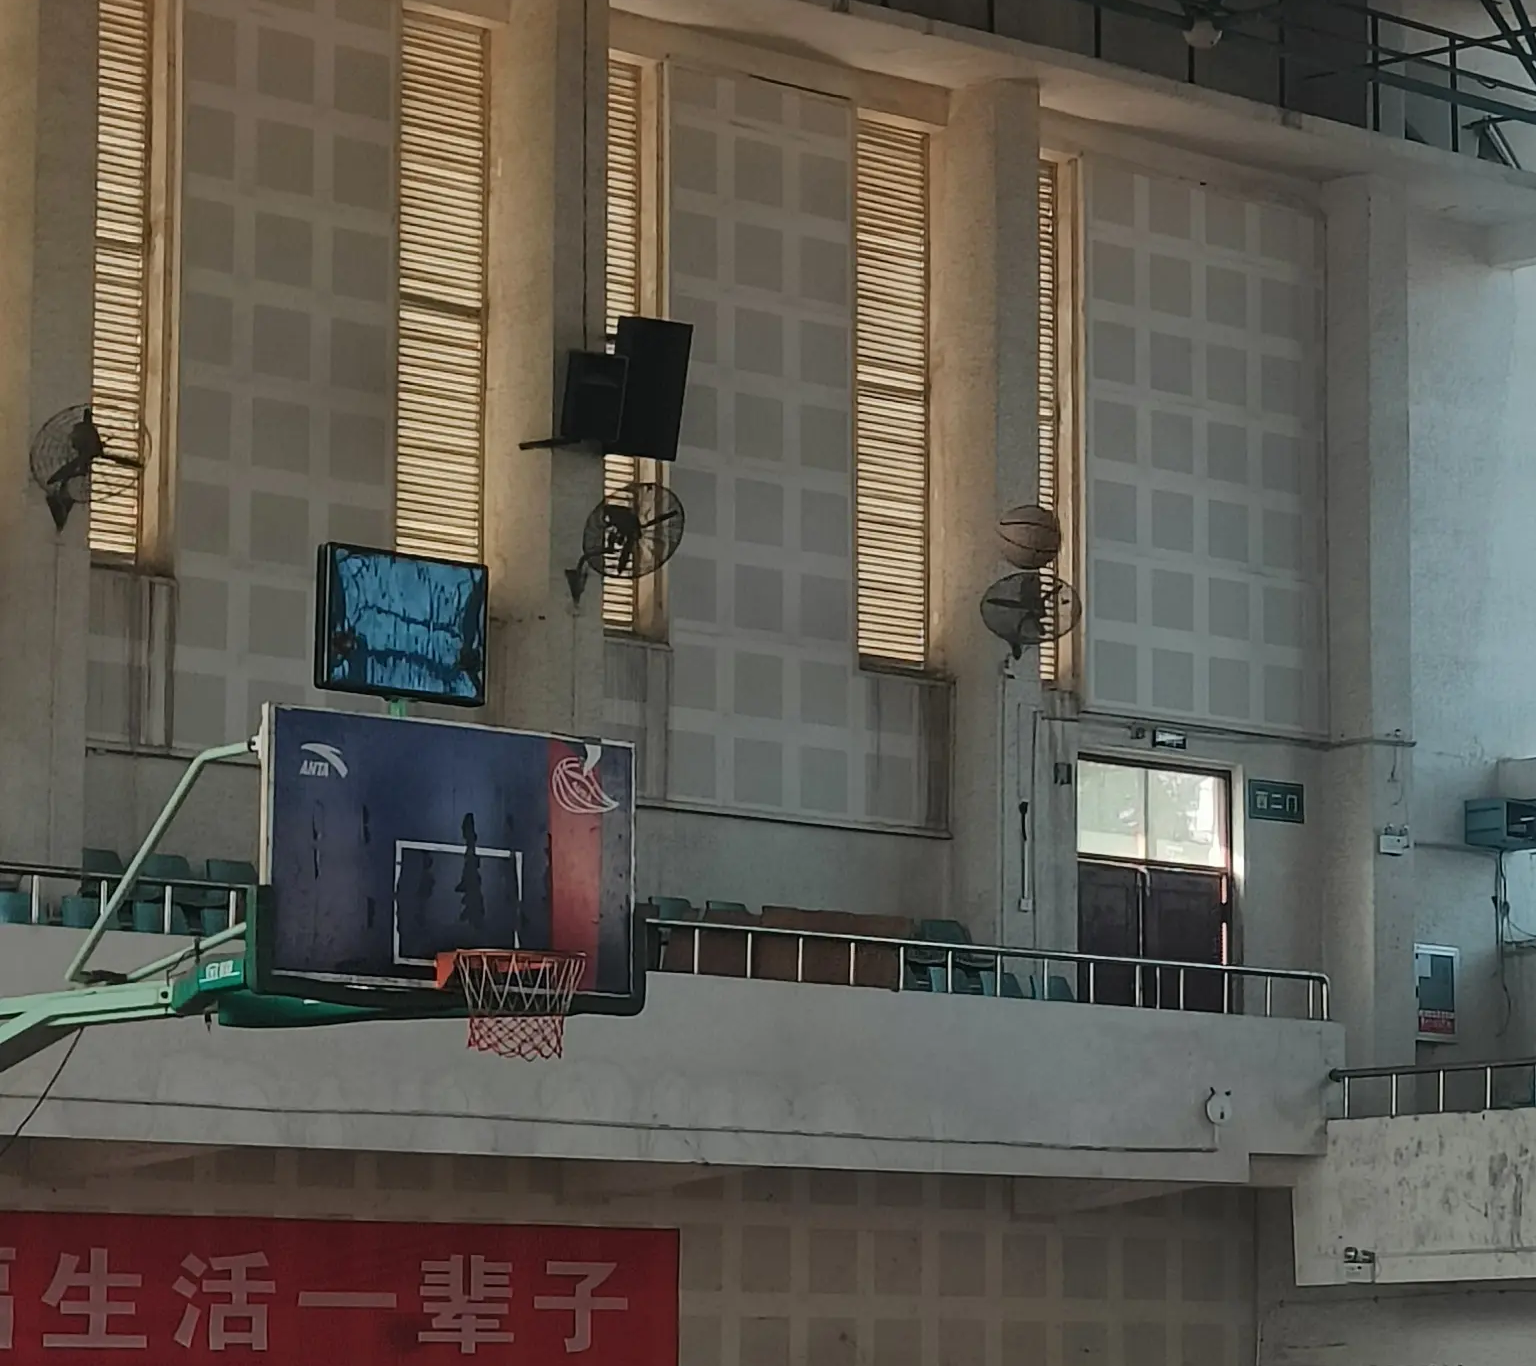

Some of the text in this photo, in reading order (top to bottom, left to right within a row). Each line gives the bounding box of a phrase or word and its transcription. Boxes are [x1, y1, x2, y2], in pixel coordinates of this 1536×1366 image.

[299, 759, 329, 777] ANTA
[0, 1245, 628, 1354] 生活一辈子
